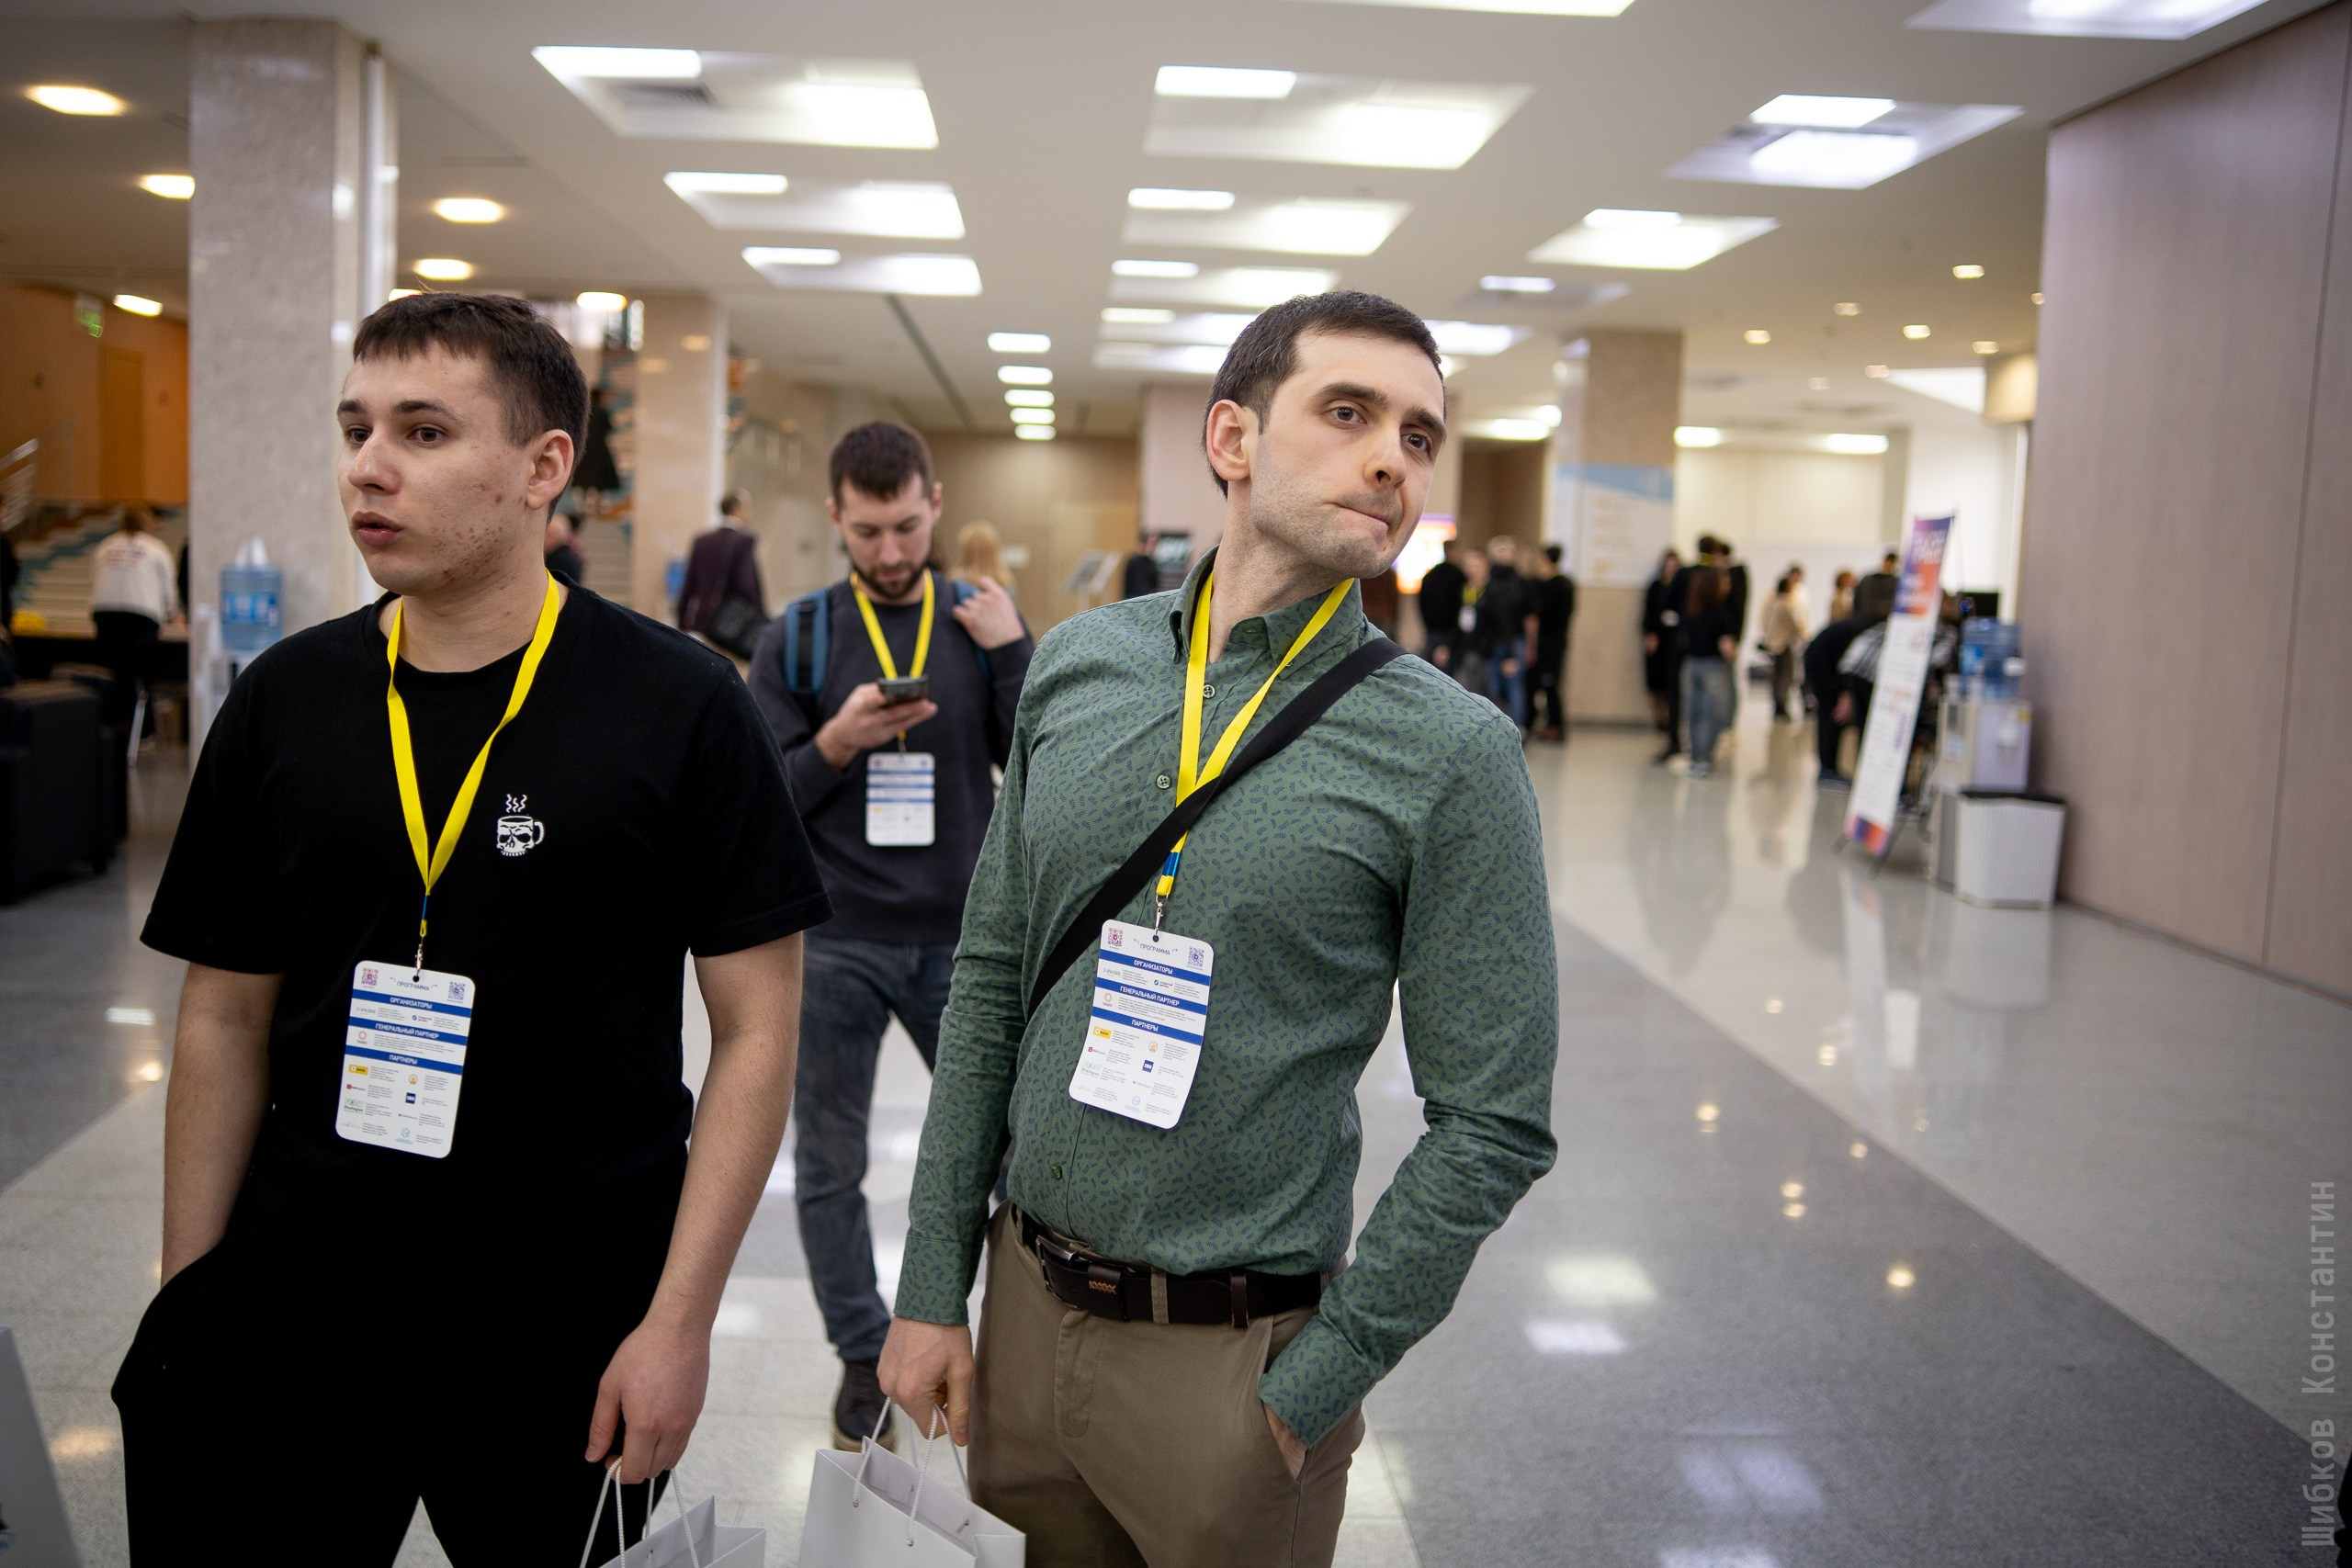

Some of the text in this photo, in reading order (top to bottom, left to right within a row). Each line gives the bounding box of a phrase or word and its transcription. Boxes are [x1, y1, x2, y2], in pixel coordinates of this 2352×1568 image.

[1139, 943, 1170, 955] ПРОГРАММА
[1134, 959, 1173, 975] ОРГАНИЗАТОРЫ
[397, 981, 430, 991] ПРОГРАММА
[1120, 986, 1180, 1006] ГЕНЕРАЛЬНЫЙ ПАРТНЕР
[390, 997, 433, 1010] ОРГАНИЗАТОРЫ
[375, 1022, 439, 1039] ГЕНЕРАЛЬНЫЙ ПАРТНЕР
[1132, 1020, 1159, 1032] ПАРТНЕРЫ
[389, 1055, 418, 1065] ПАРТНЕРЫ
